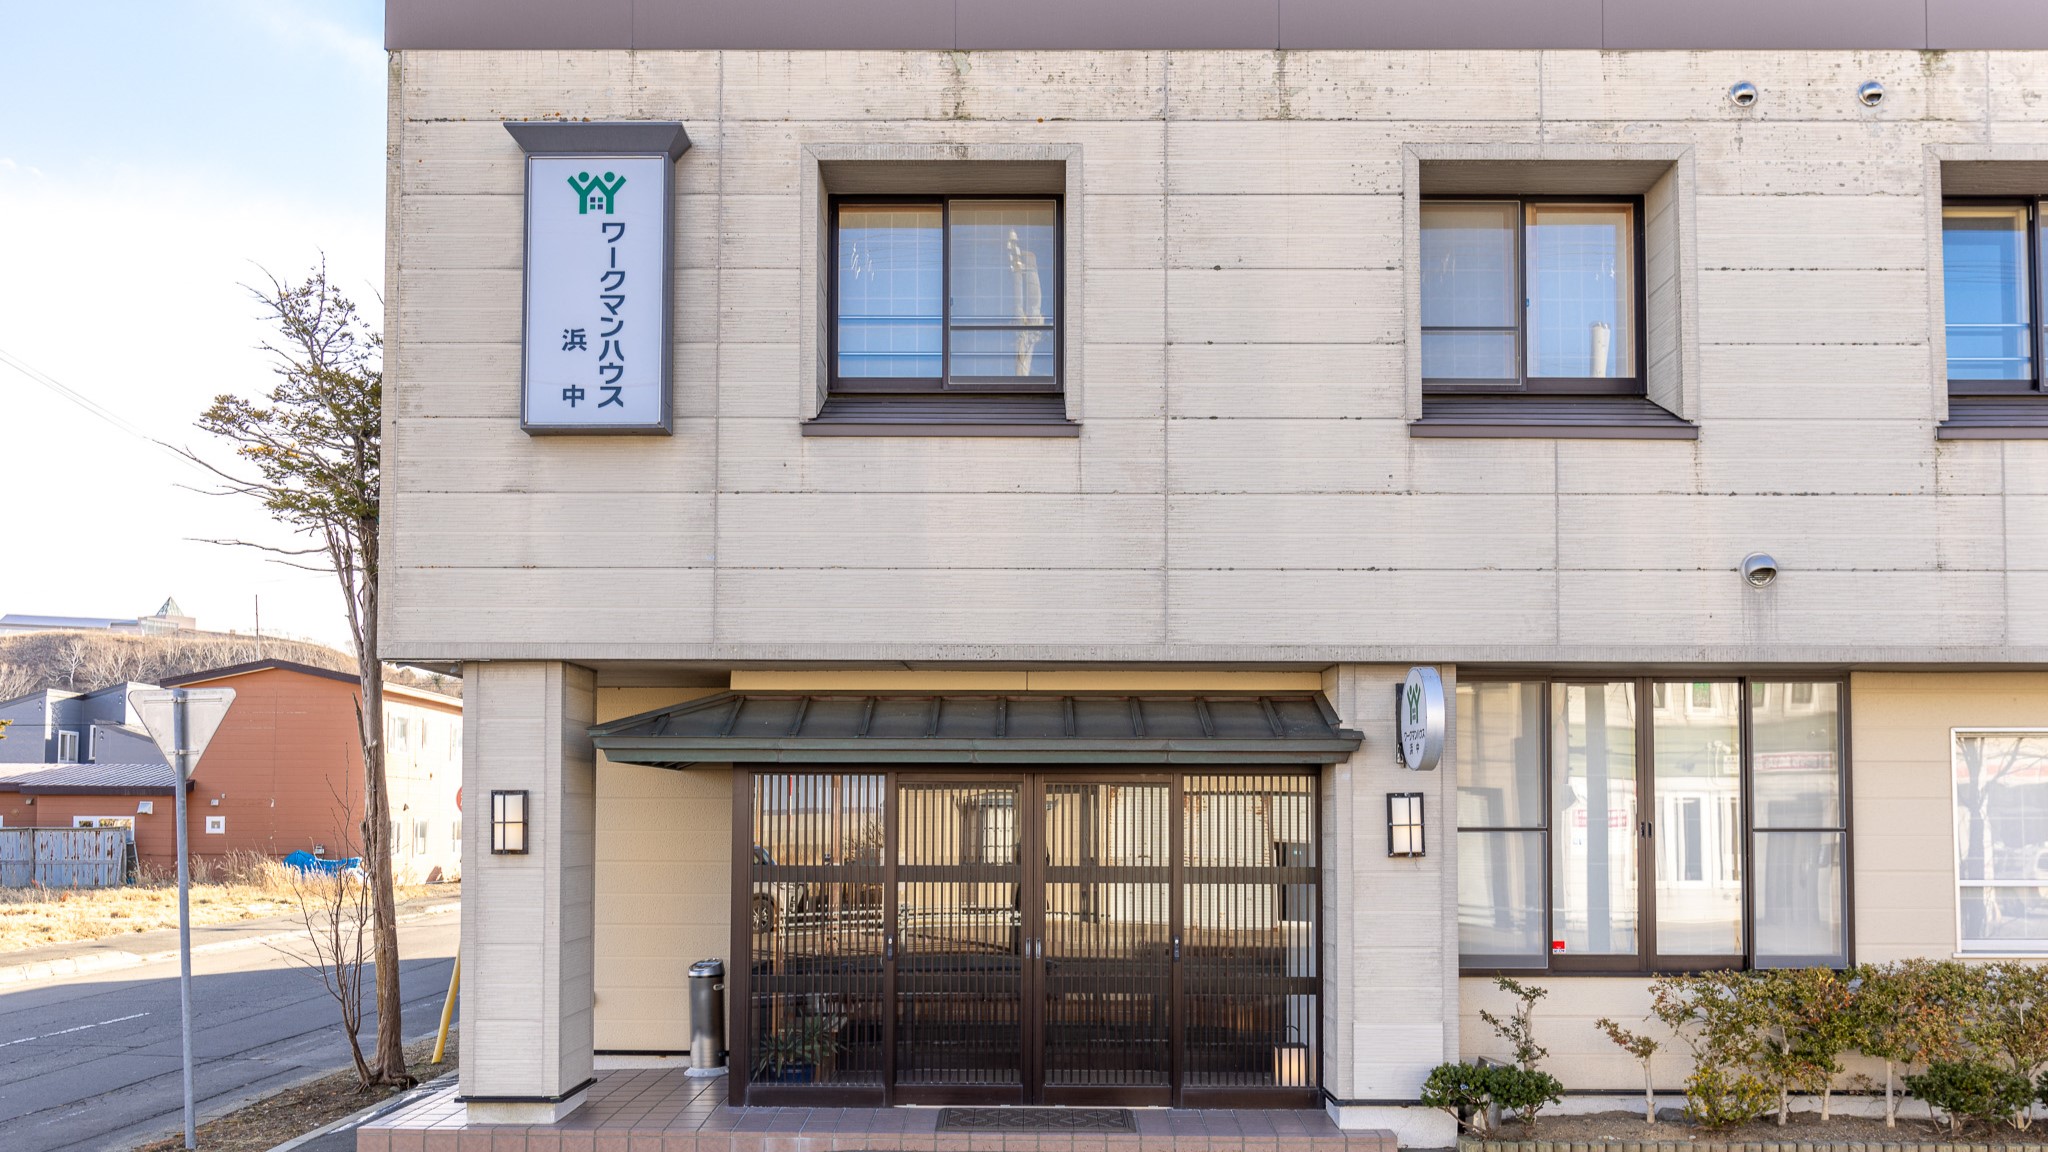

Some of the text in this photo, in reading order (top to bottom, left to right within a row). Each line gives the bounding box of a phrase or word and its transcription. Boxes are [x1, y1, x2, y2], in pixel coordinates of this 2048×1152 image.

[561, 328, 588, 409] 浜中
[598, 222, 626, 409] ワークマンハウス
